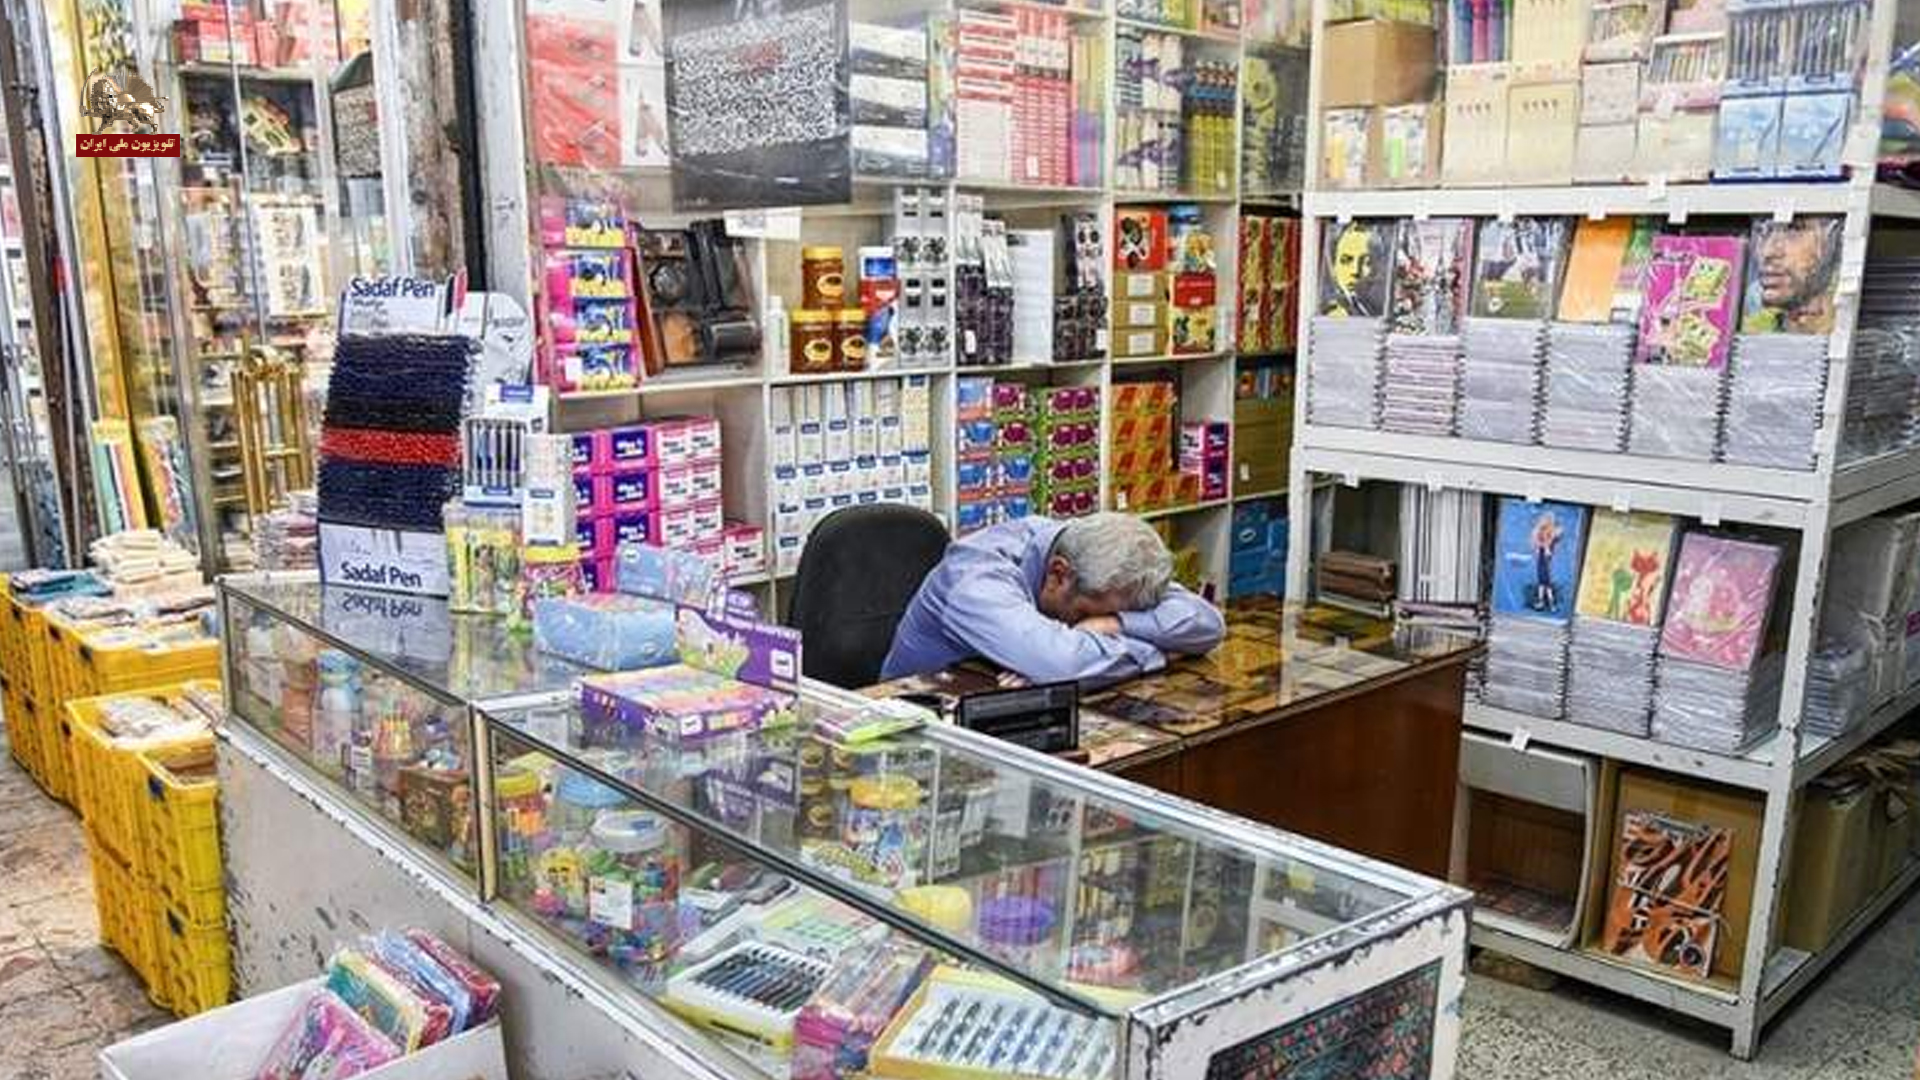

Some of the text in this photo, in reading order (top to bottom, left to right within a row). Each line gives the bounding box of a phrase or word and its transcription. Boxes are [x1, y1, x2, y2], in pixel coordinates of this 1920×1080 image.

[351, 276, 435, 299] Sadaf Pen
[340, 561, 422, 588] Sadaf Pen
